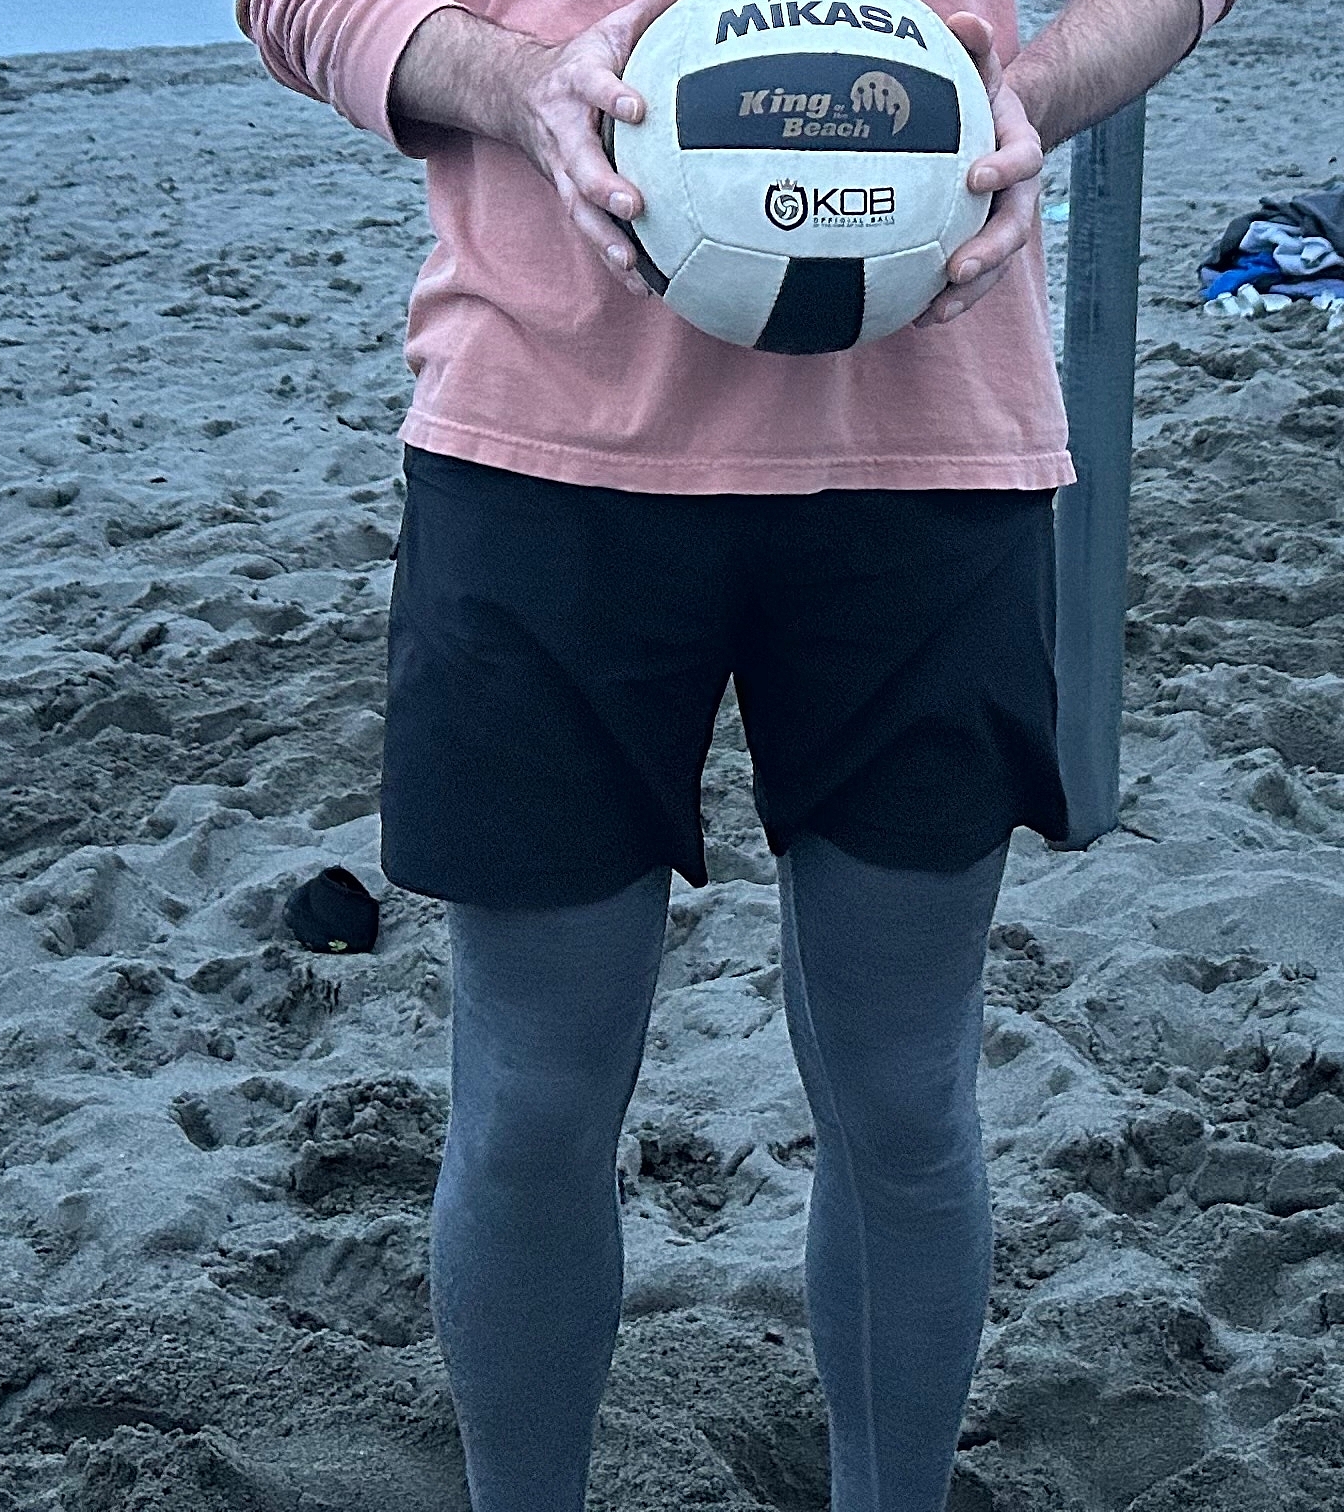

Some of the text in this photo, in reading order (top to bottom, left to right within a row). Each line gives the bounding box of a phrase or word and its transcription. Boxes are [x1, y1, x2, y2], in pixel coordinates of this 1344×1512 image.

[739, 87, 832, 119] King
[782, 118, 871, 138] Beach
[813, 187, 895, 216] KOB
